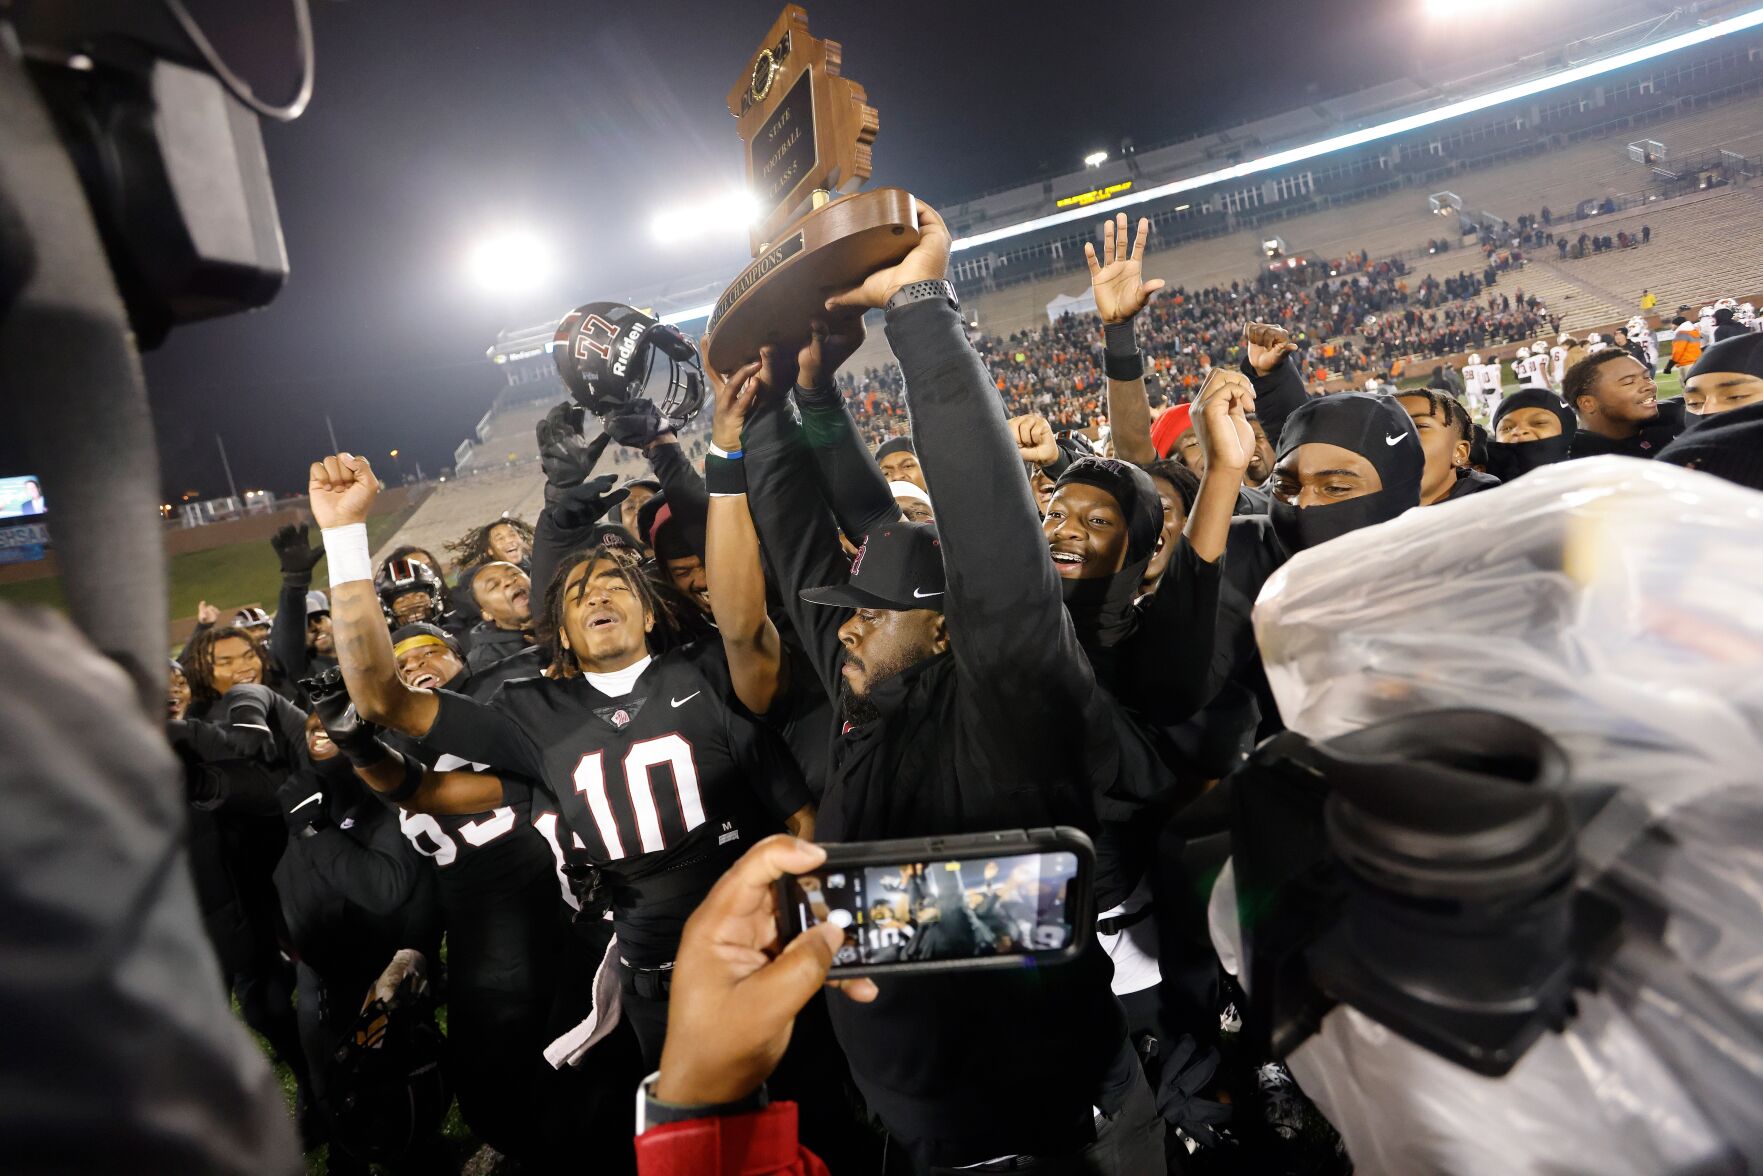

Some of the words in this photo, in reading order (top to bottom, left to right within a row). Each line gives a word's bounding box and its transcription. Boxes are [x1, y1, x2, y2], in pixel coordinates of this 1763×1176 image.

[768, 106, 791, 142] STATE
[763, 127, 802, 177] FOOTBALL
[769, 166, 792, 199] CLASS
[713, 297, 729, 327] STATE
[729, 247, 783, 303] CHAMPIONS
[574, 313, 621, 360] 77
[613, 322, 646, 377] Riddell
[571, 731, 706, 861] 10
[722, 821, 732, 831] M
